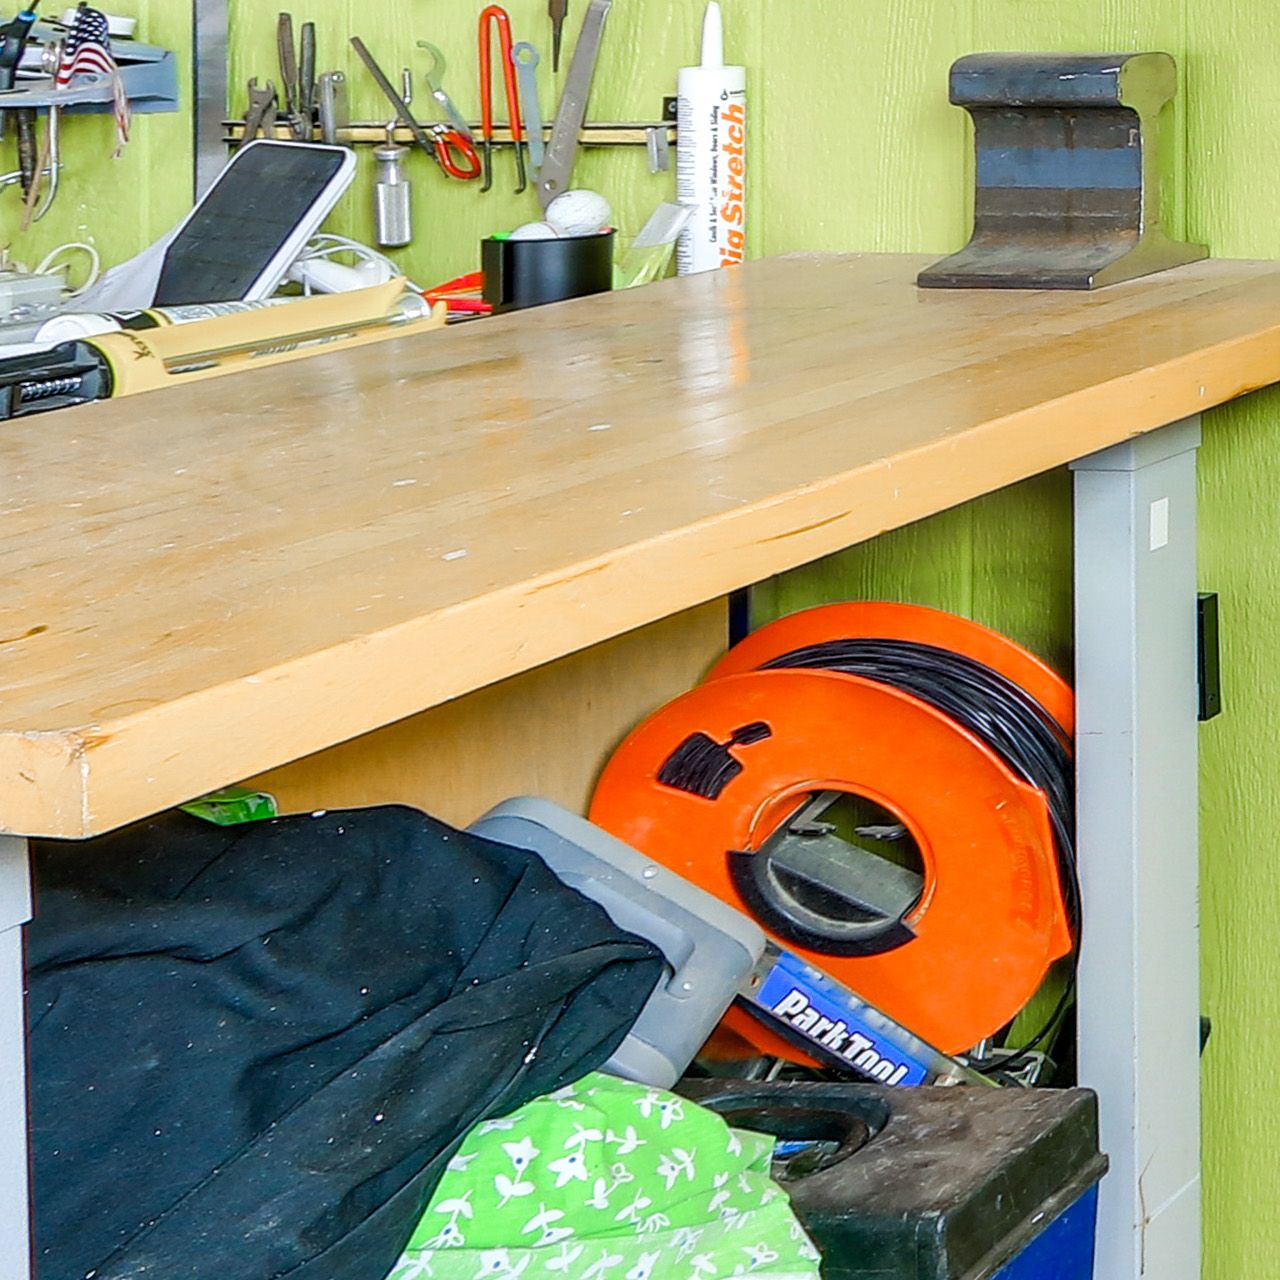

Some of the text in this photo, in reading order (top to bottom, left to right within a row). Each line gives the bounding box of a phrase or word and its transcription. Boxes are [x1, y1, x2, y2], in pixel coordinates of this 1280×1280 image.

[709, 105, 720, 125] Siding
[719, 103, 744, 225] Stretch
[771, 986, 909, 1086] ParkTool
